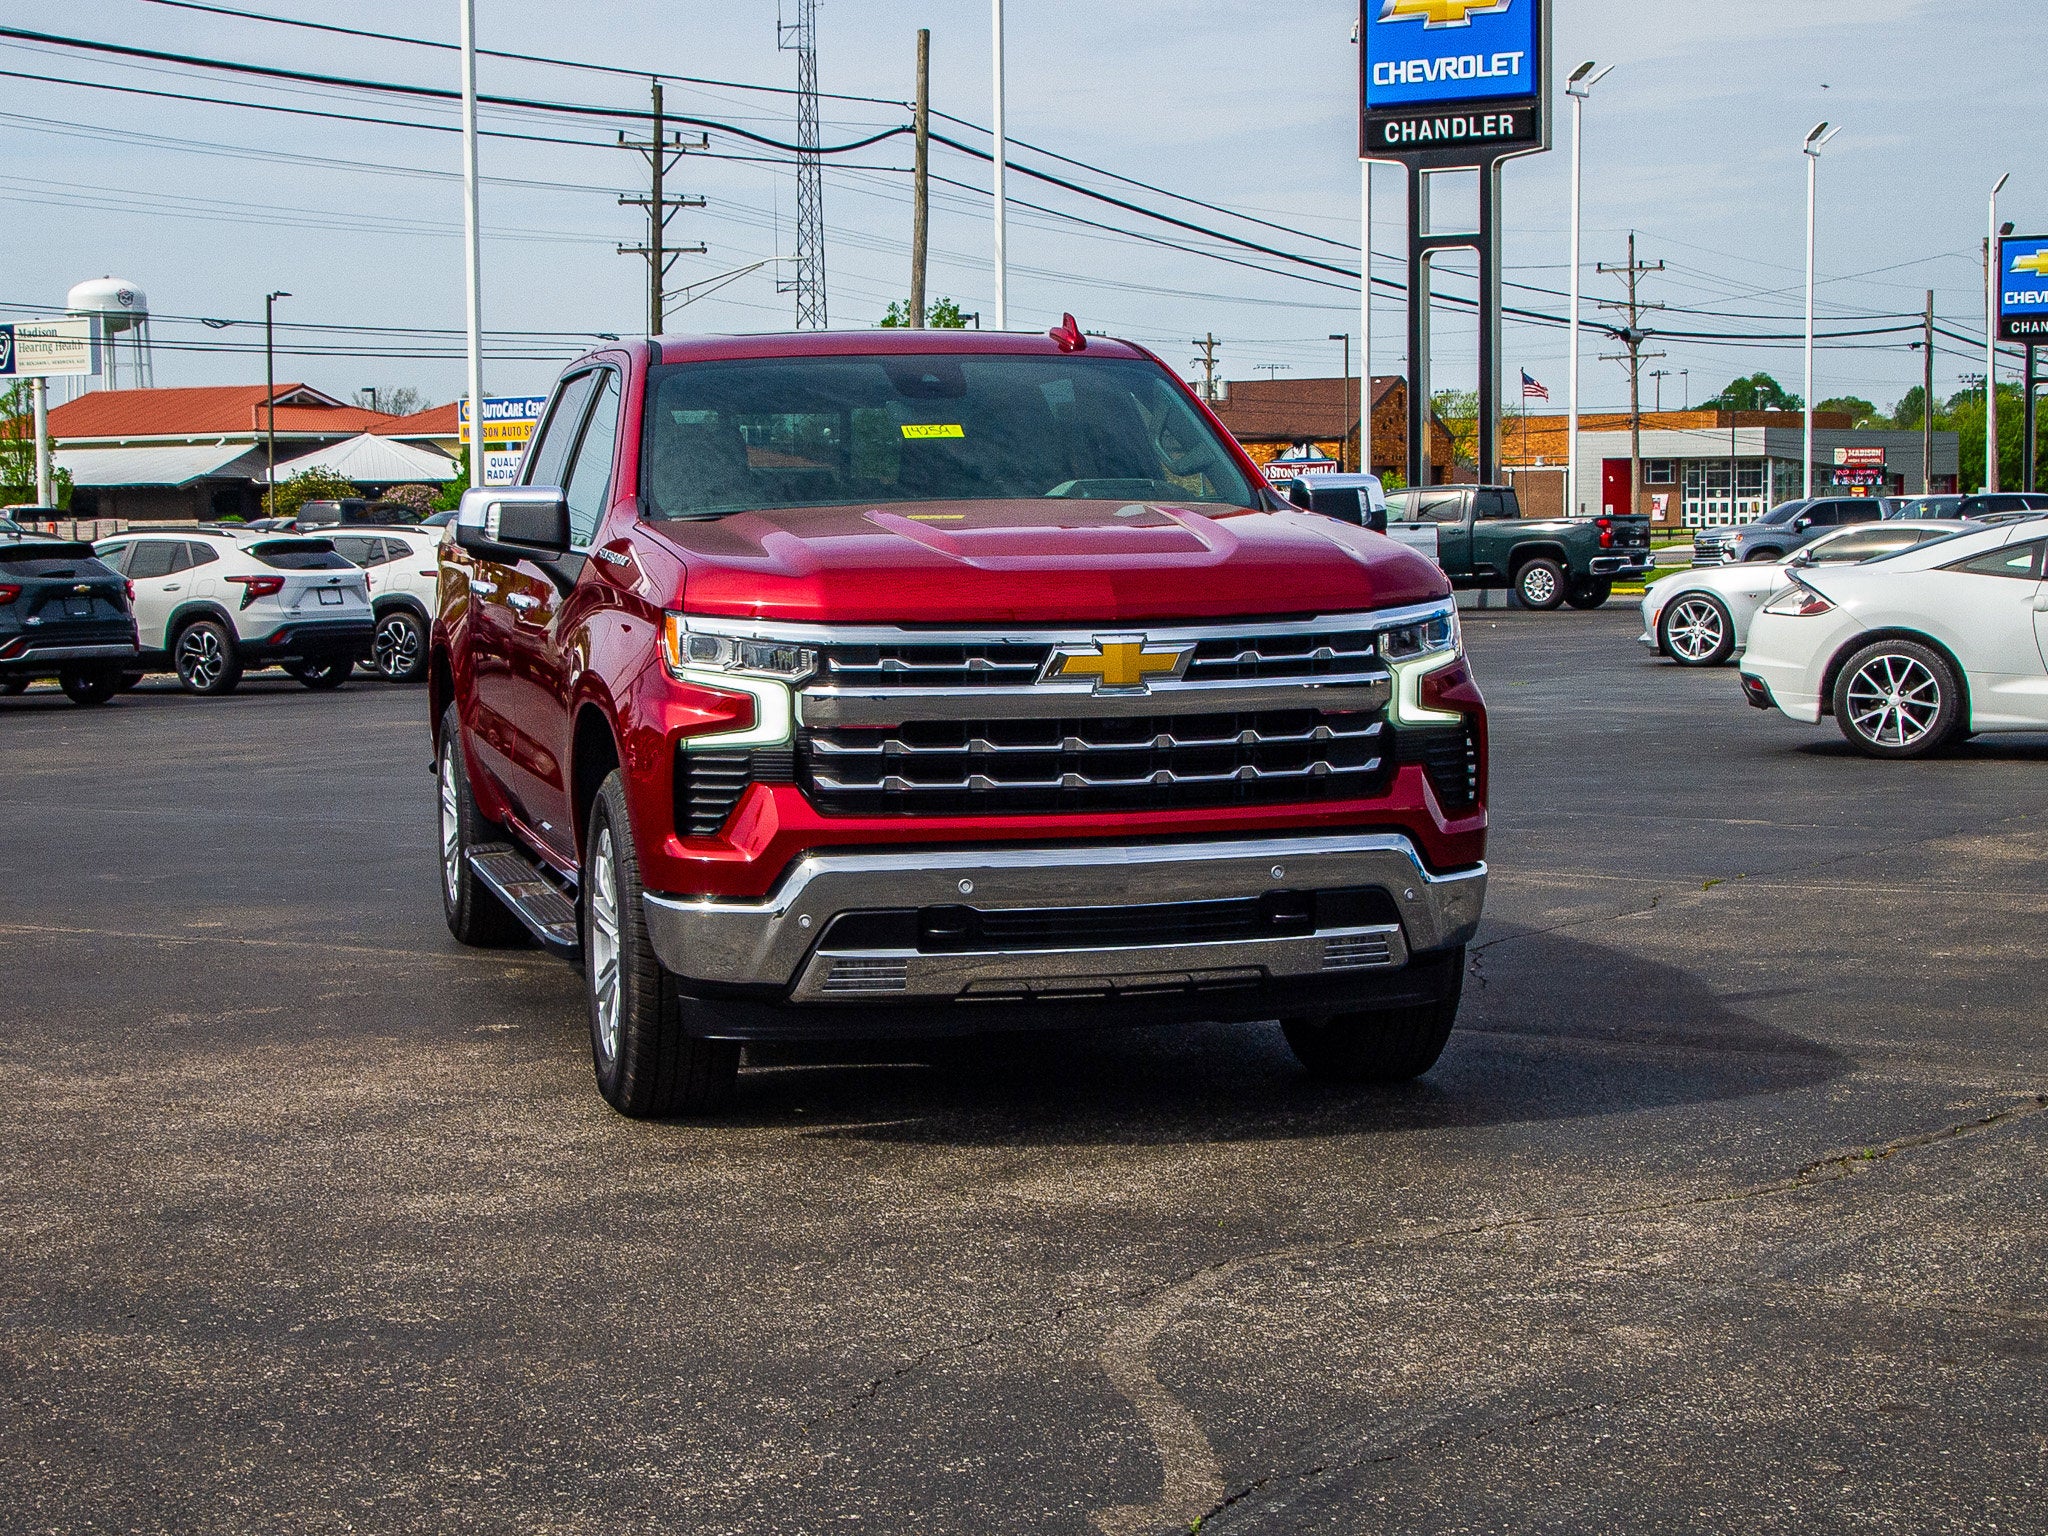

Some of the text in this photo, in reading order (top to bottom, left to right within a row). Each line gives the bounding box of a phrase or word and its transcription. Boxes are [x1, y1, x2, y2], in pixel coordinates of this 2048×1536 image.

[1373, 51, 1524, 86] CHEVROLET
[1384, 114, 1514, 143] CHANDLER
[18, 327, 58, 339] Madison
[18, 339, 84, 354] Hearing Health
[463, 427, 498, 438] MSON
[502, 426, 521, 436] AUTO
[487, 469, 515, 479] RADIA
[1270, 466, 1299, 479] STONE
